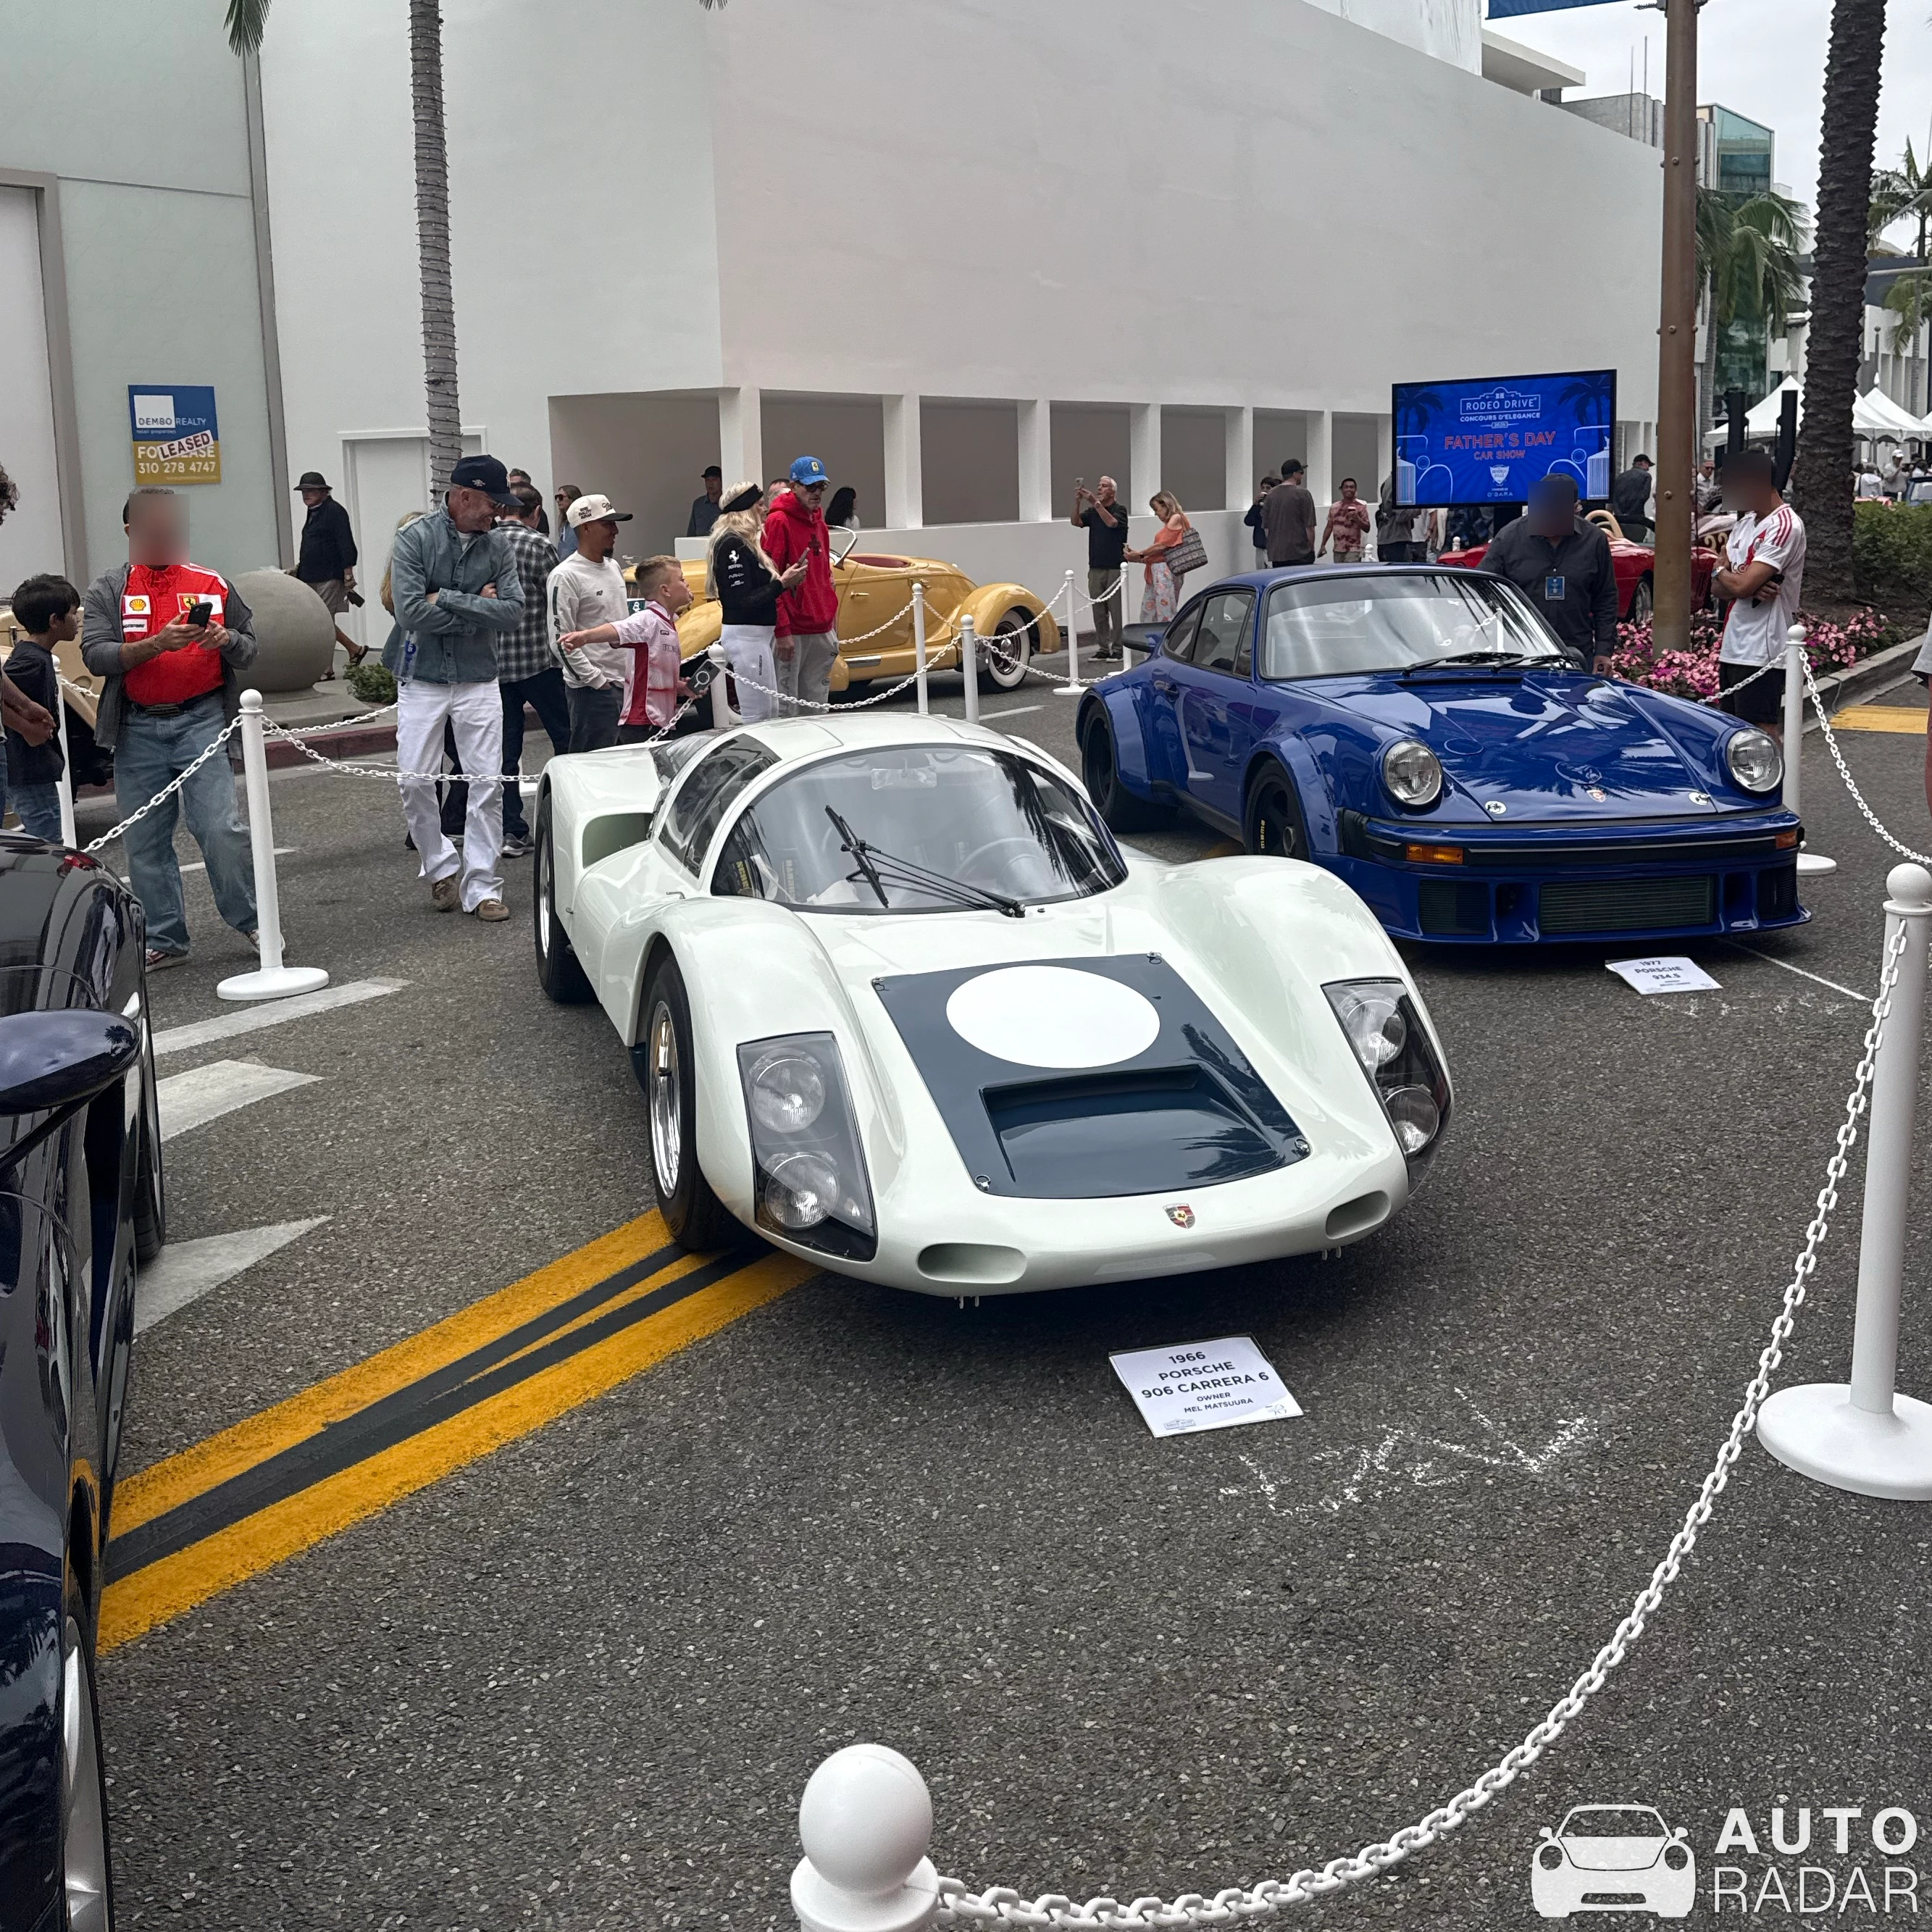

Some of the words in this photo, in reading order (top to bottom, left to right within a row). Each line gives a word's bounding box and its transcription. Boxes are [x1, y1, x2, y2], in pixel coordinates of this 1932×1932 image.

[1466, 401, 1500, 410] RODEO
[1504, 398, 1535, 409] DRIVE
[138, 417, 172, 426] DEMBO
[175, 417, 206, 426] REALTY
[159, 432, 210, 459] LEASED
[1444, 433, 1520, 450] FATHER'S
[1524, 431, 1556, 446] DAY
[137, 446, 159, 459] FO
[1473, 451, 1494, 461] CAR
[1497, 449, 1526, 459] SHOW
[138, 462, 159, 474] 310
[163, 461, 185, 474] 278
[189, 461, 217, 473] 4747
[1168, 1350, 1207, 1365] 1966
[1158, 1360, 1236, 1381] PORSCHE
[1141, 1385, 1174, 1399] 906
[1176, 1373, 1257, 1394] CARRERA
[1258, 1371, 1270, 1381] 6
[1196, 1391, 1231, 1402] OWNER
[1184, 1405, 1203, 1414] MEL
[1204, 1397, 1254, 1411] MATSUURA
